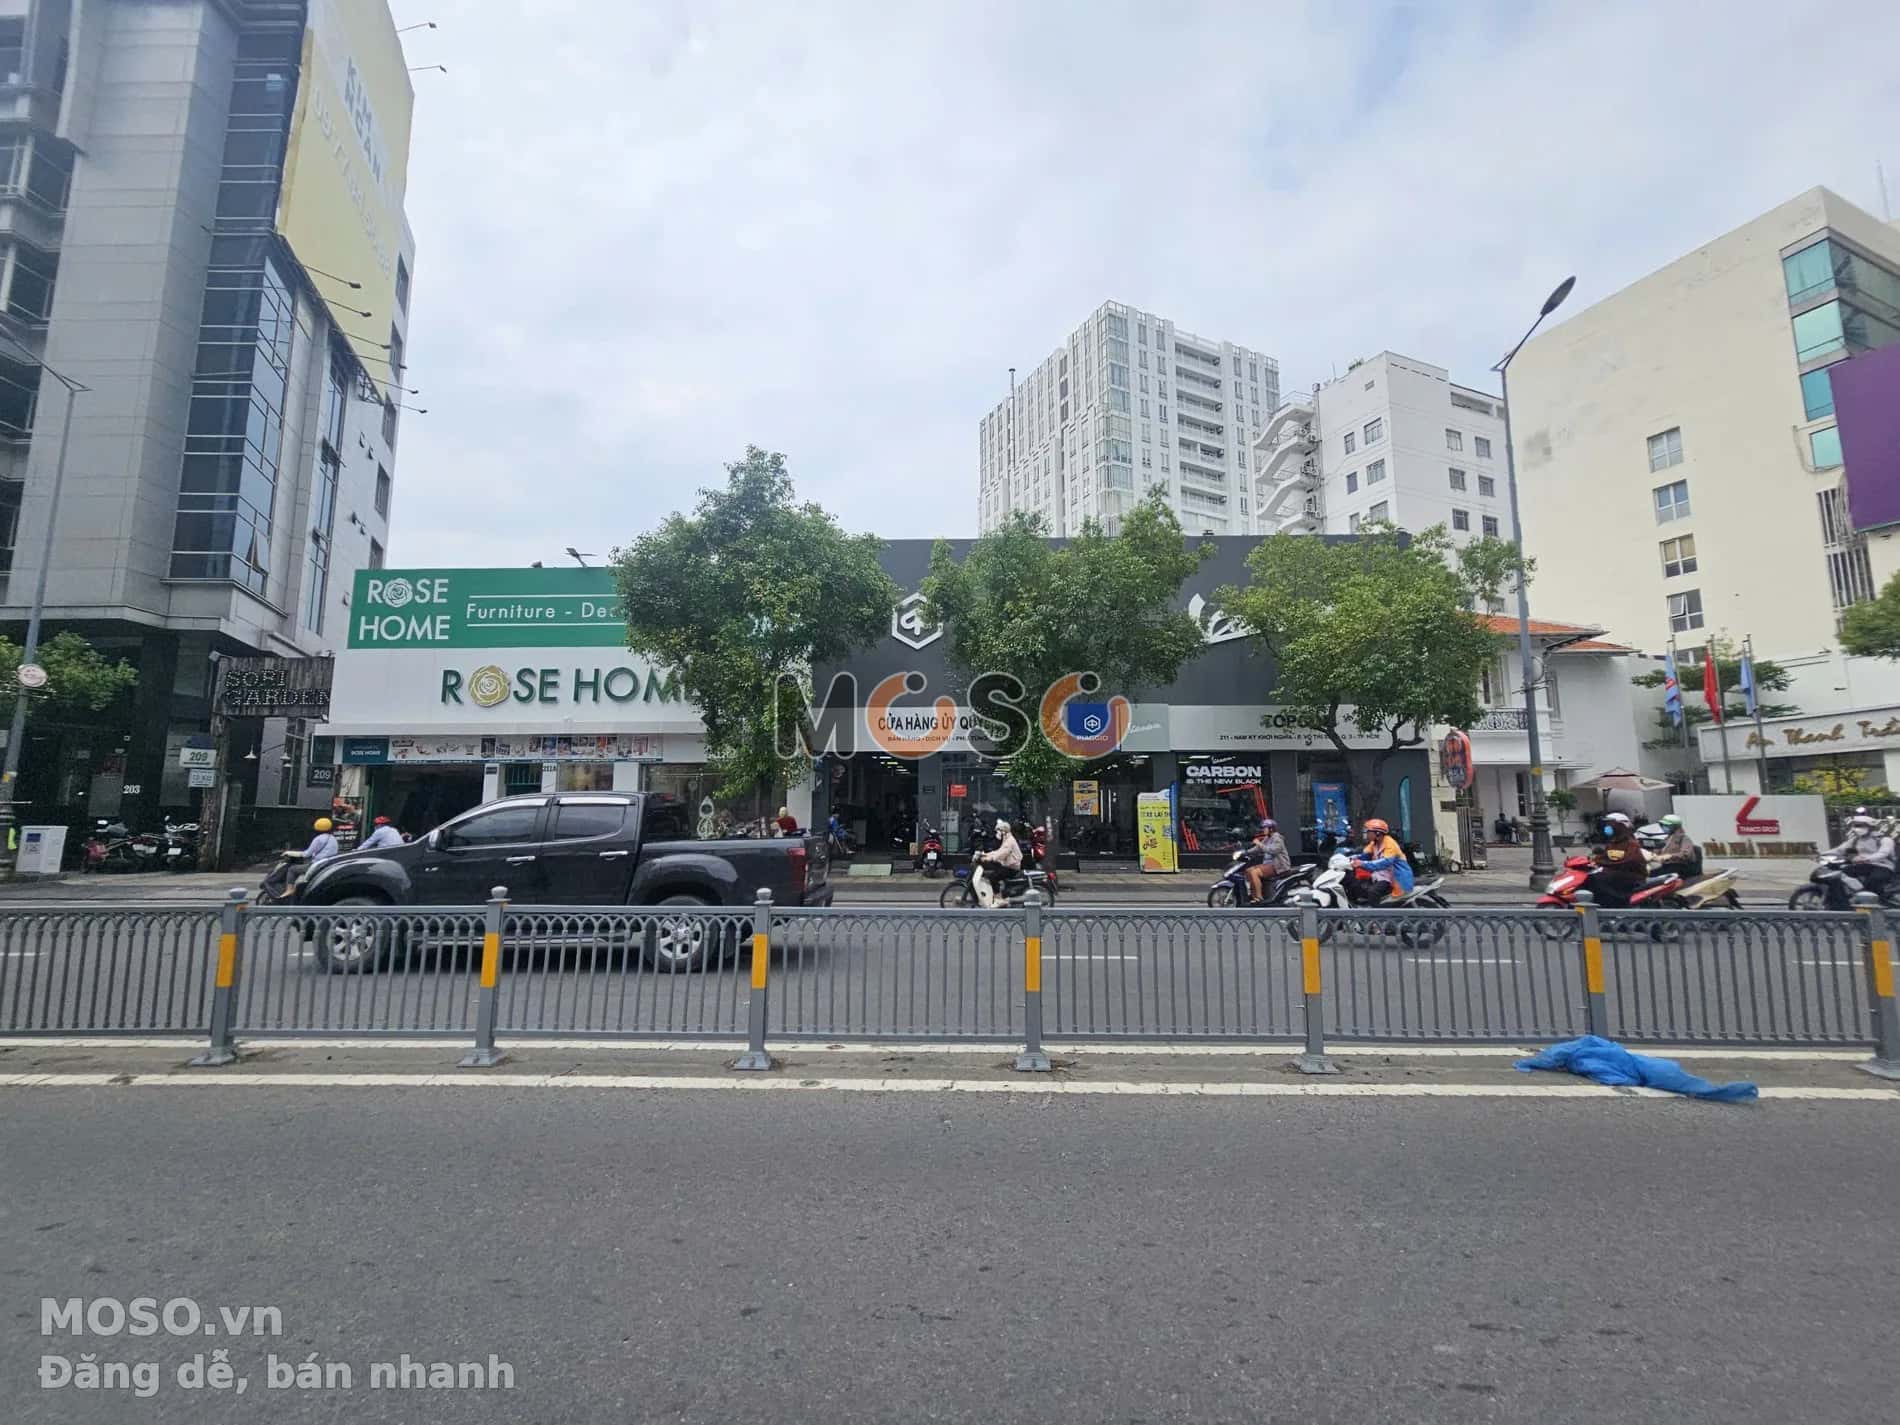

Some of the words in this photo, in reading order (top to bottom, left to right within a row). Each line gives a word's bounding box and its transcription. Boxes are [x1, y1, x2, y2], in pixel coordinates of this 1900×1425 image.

[465, 602, 556, 619] Furniture
[359, 615, 450, 641] HOME
[573, 666, 694, 704] HOM
[223, 688, 330, 705] GARDEN
[878, 712, 903, 730] CỬA
[905, 712, 938, 730] HÀNG
[942, 712, 956, 730] ỦY
[189, 751, 209, 761] 209
[313, 769, 331, 779] 209
[1186, 766, 1262, 777] CARBON
[123, 785, 141, 794] 203
